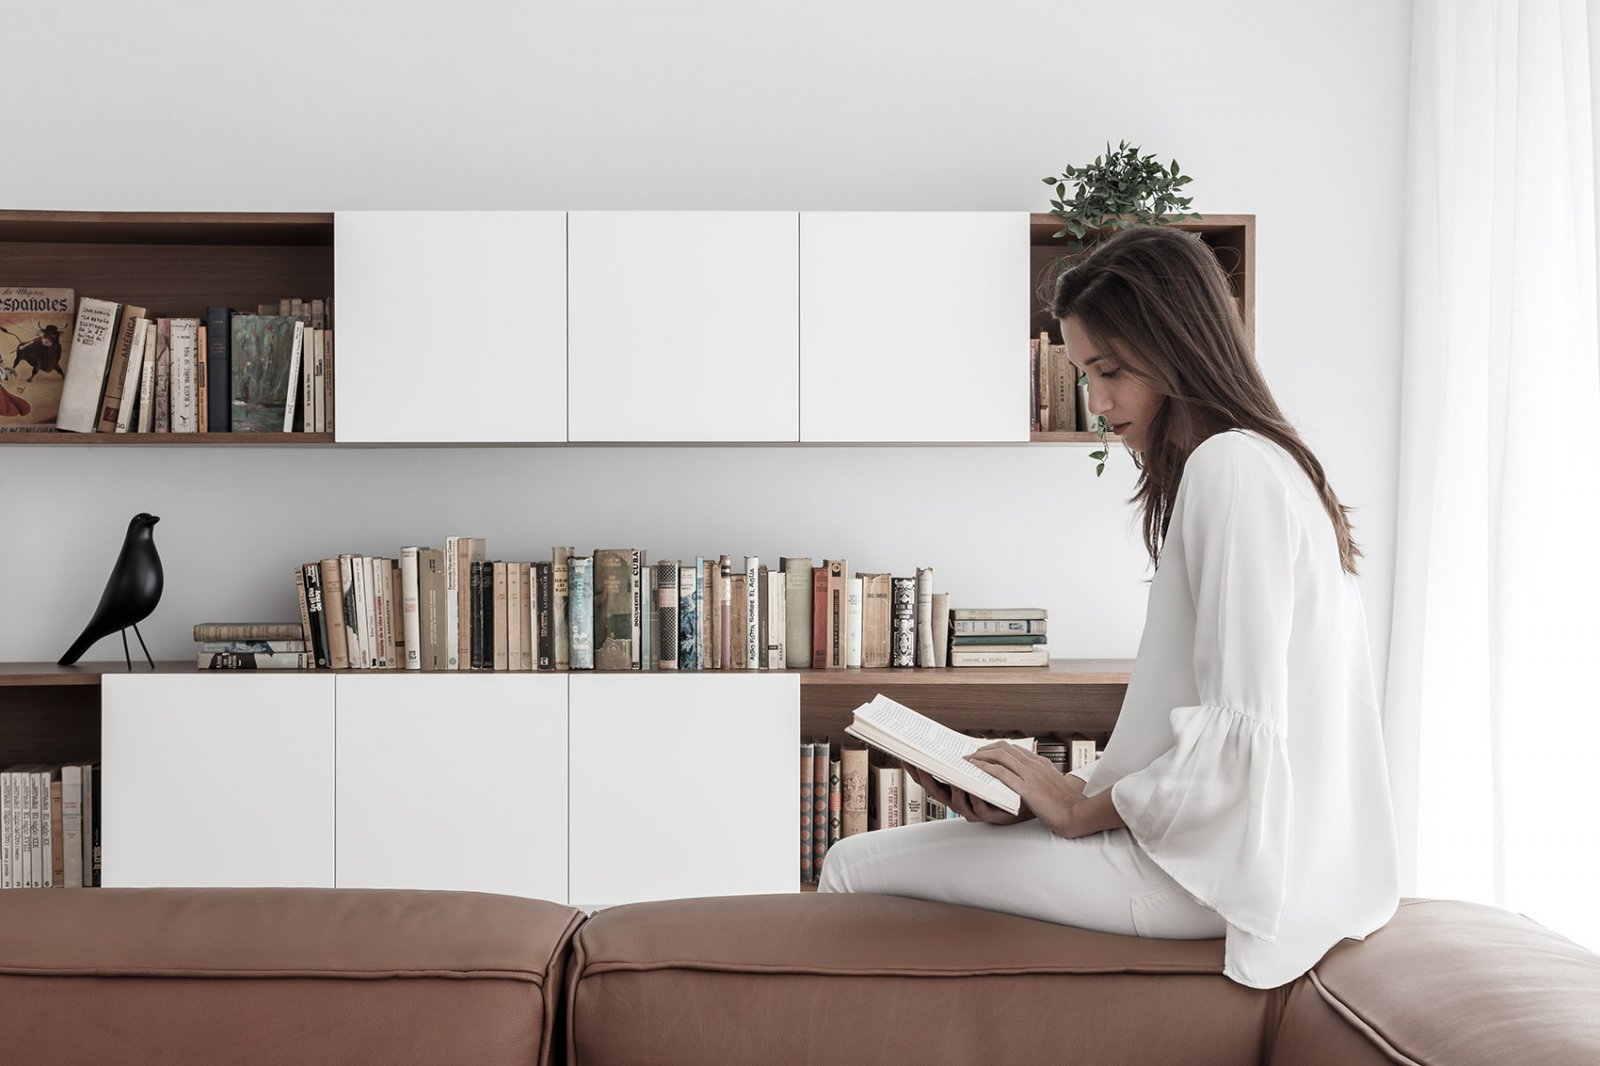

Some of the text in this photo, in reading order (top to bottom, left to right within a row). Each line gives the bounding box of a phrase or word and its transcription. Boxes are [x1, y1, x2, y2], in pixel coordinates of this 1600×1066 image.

[121, 316, 137, 358] AMÉRICA
[633, 579, 639, 588] DE
[748, 588, 755, 597] EL
[43, 837, 50, 847] XX
